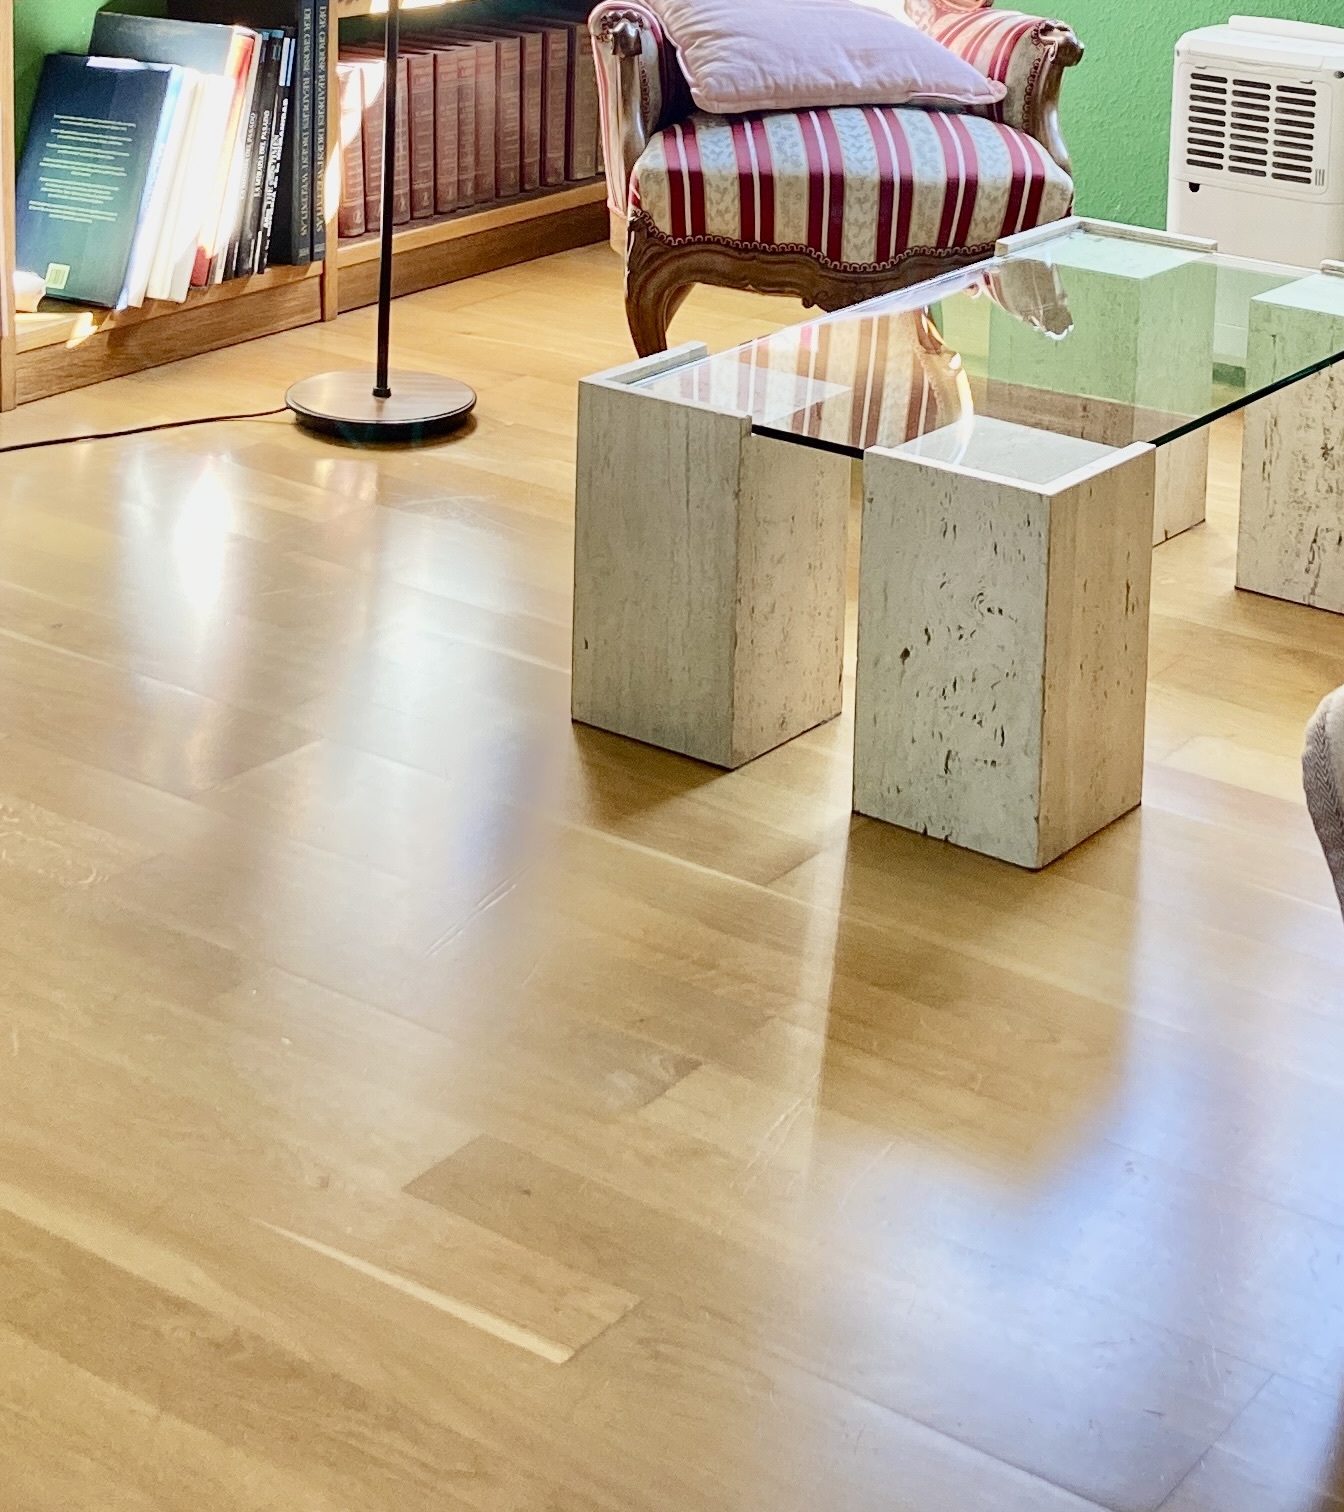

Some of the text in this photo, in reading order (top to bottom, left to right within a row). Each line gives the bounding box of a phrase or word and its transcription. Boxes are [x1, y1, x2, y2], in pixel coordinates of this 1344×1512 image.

[303, 8, 312, 31] DER
[318, 6, 328, 29] DER
[261, 110, 270, 140] PASADO
